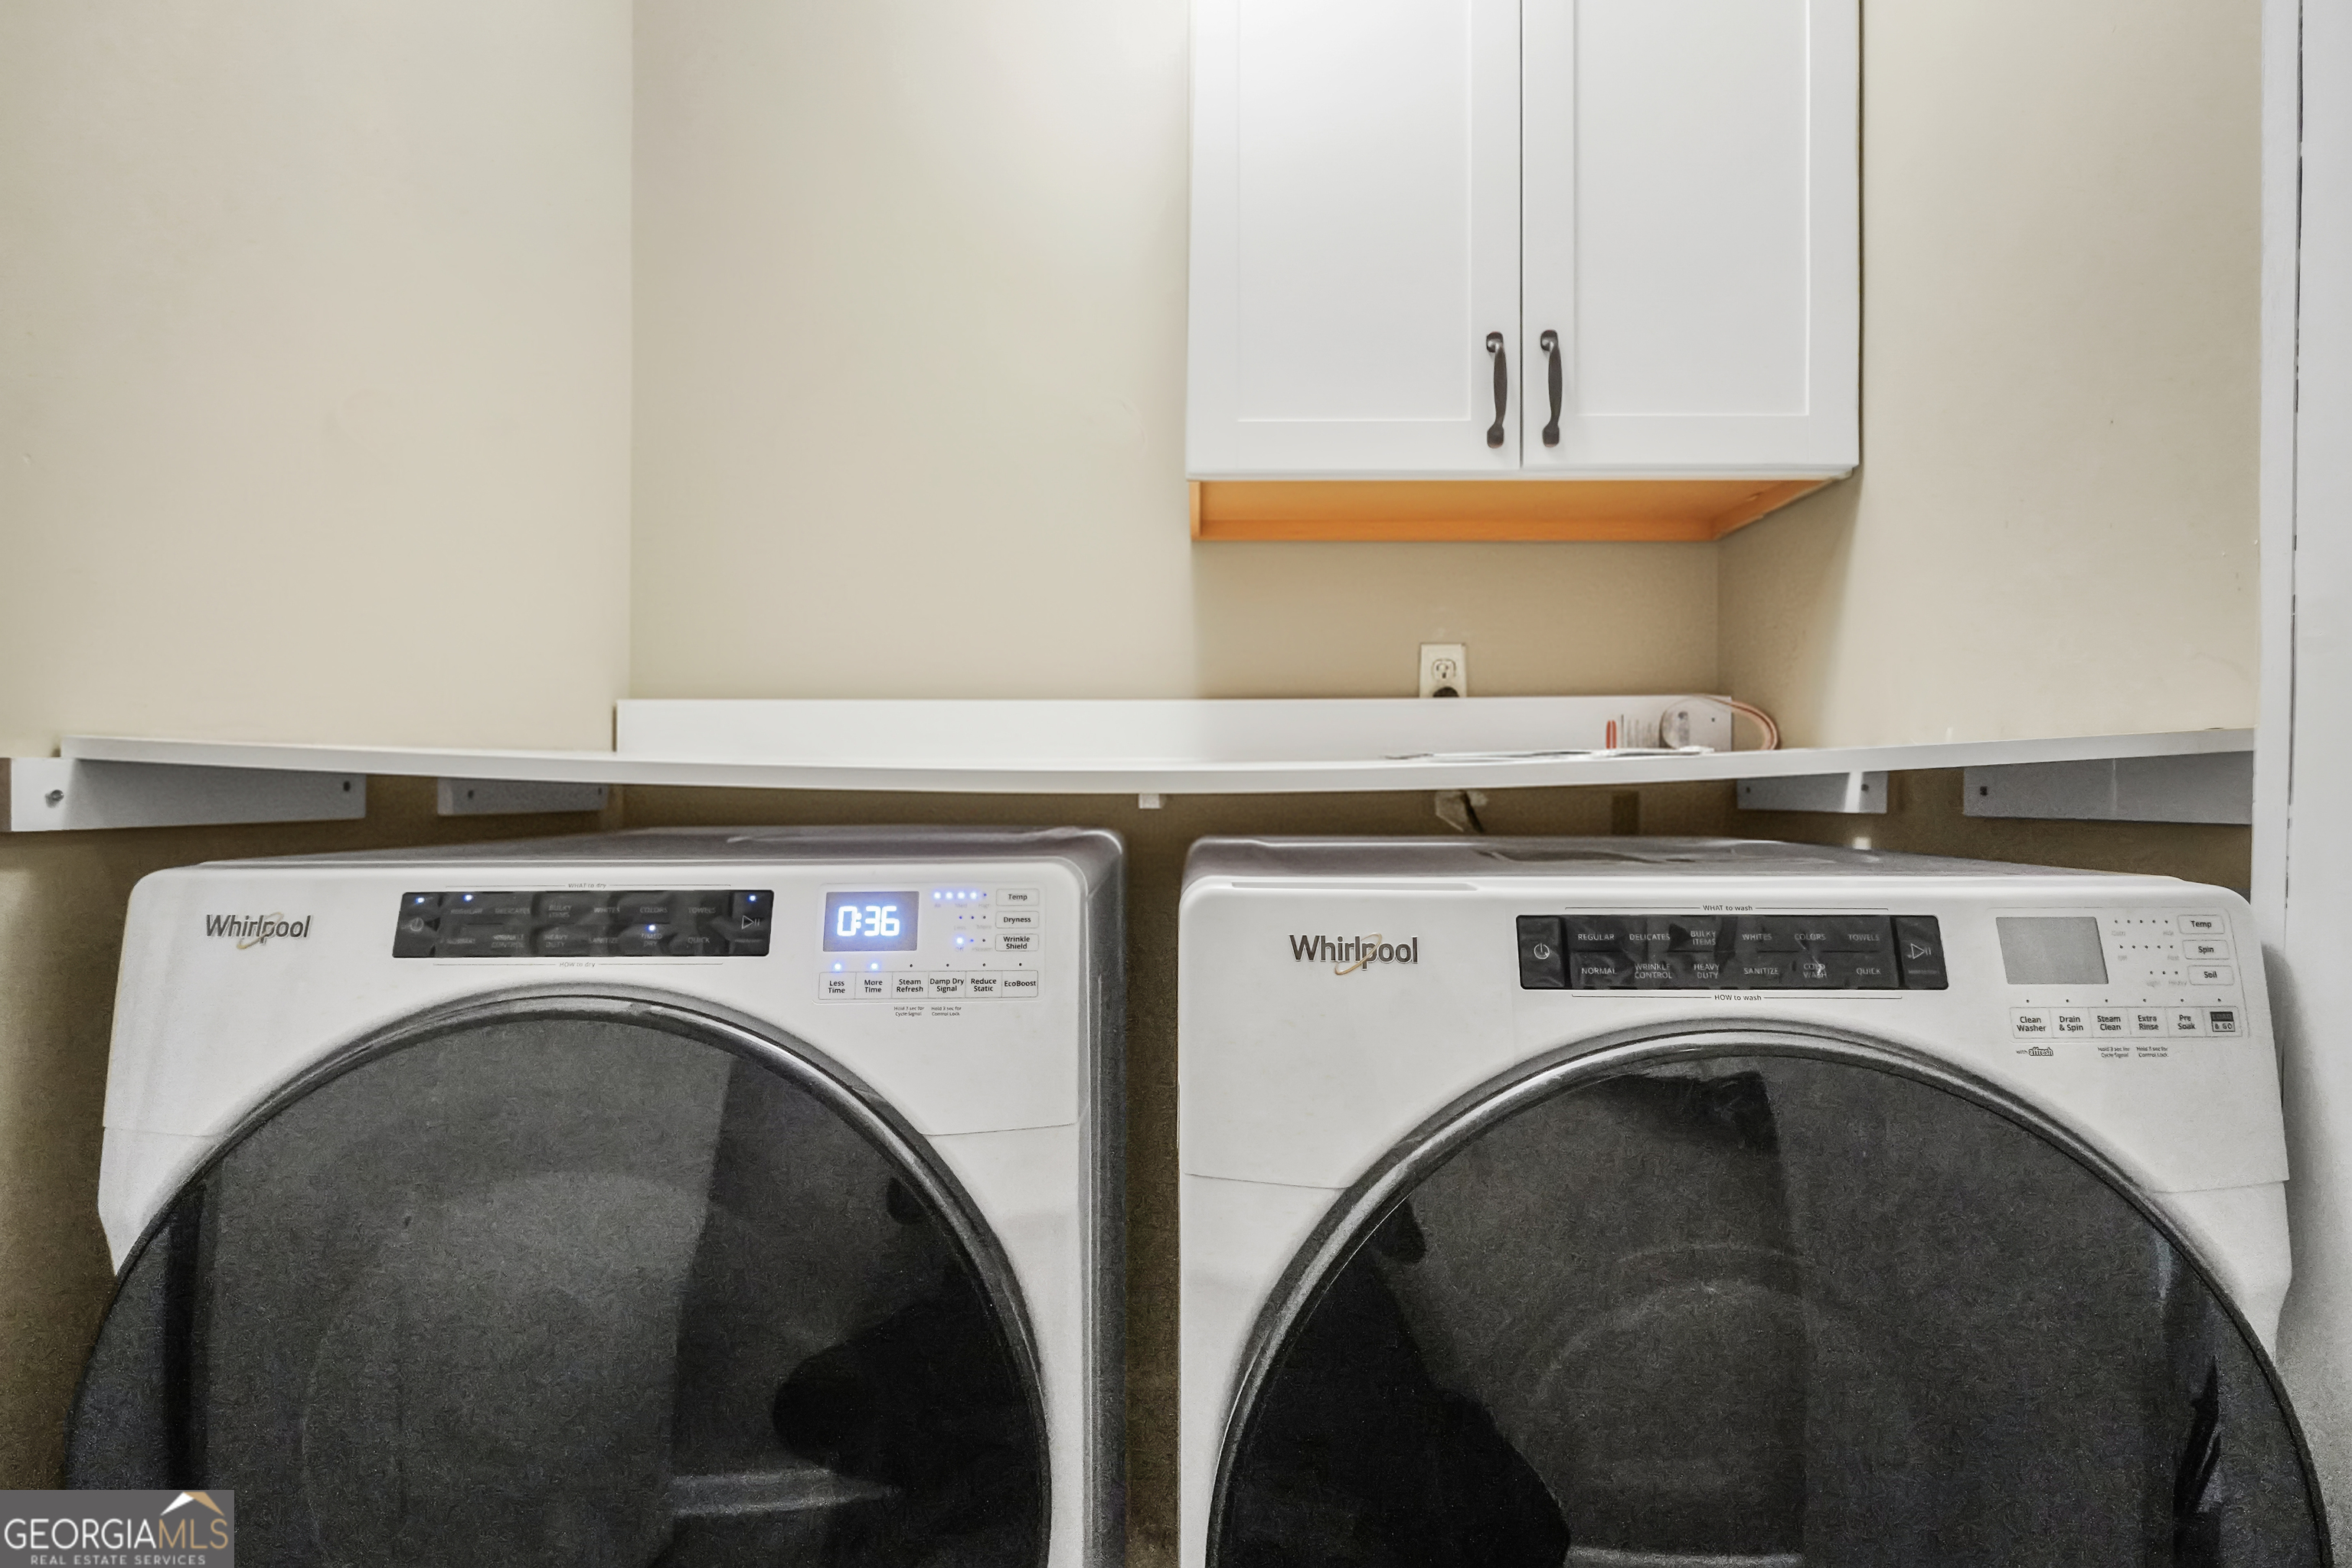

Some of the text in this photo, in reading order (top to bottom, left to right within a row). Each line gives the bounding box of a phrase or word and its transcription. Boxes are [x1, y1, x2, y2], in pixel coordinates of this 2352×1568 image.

[1008, 893, 1028, 902] Temp
[837, 906, 900, 936] 0:36
[2190, 920, 2212, 929] Temp
[206, 914, 312, 945] Whirlpool
[1289, 934, 1419, 970] Whirlpool
[2198, 946, 2214, 955] Spin
[1856, 967, 1882, 975] QUICK
[929, 978, 965, 987] Damp Dry
[1004, 979, 1037, 988] EcoBoost
[2067, 1024, 2084, 1032] Spin
[2177, 1022, 2196, 1031] Soak
[2028, 1047, 2053, 1056] affresh
